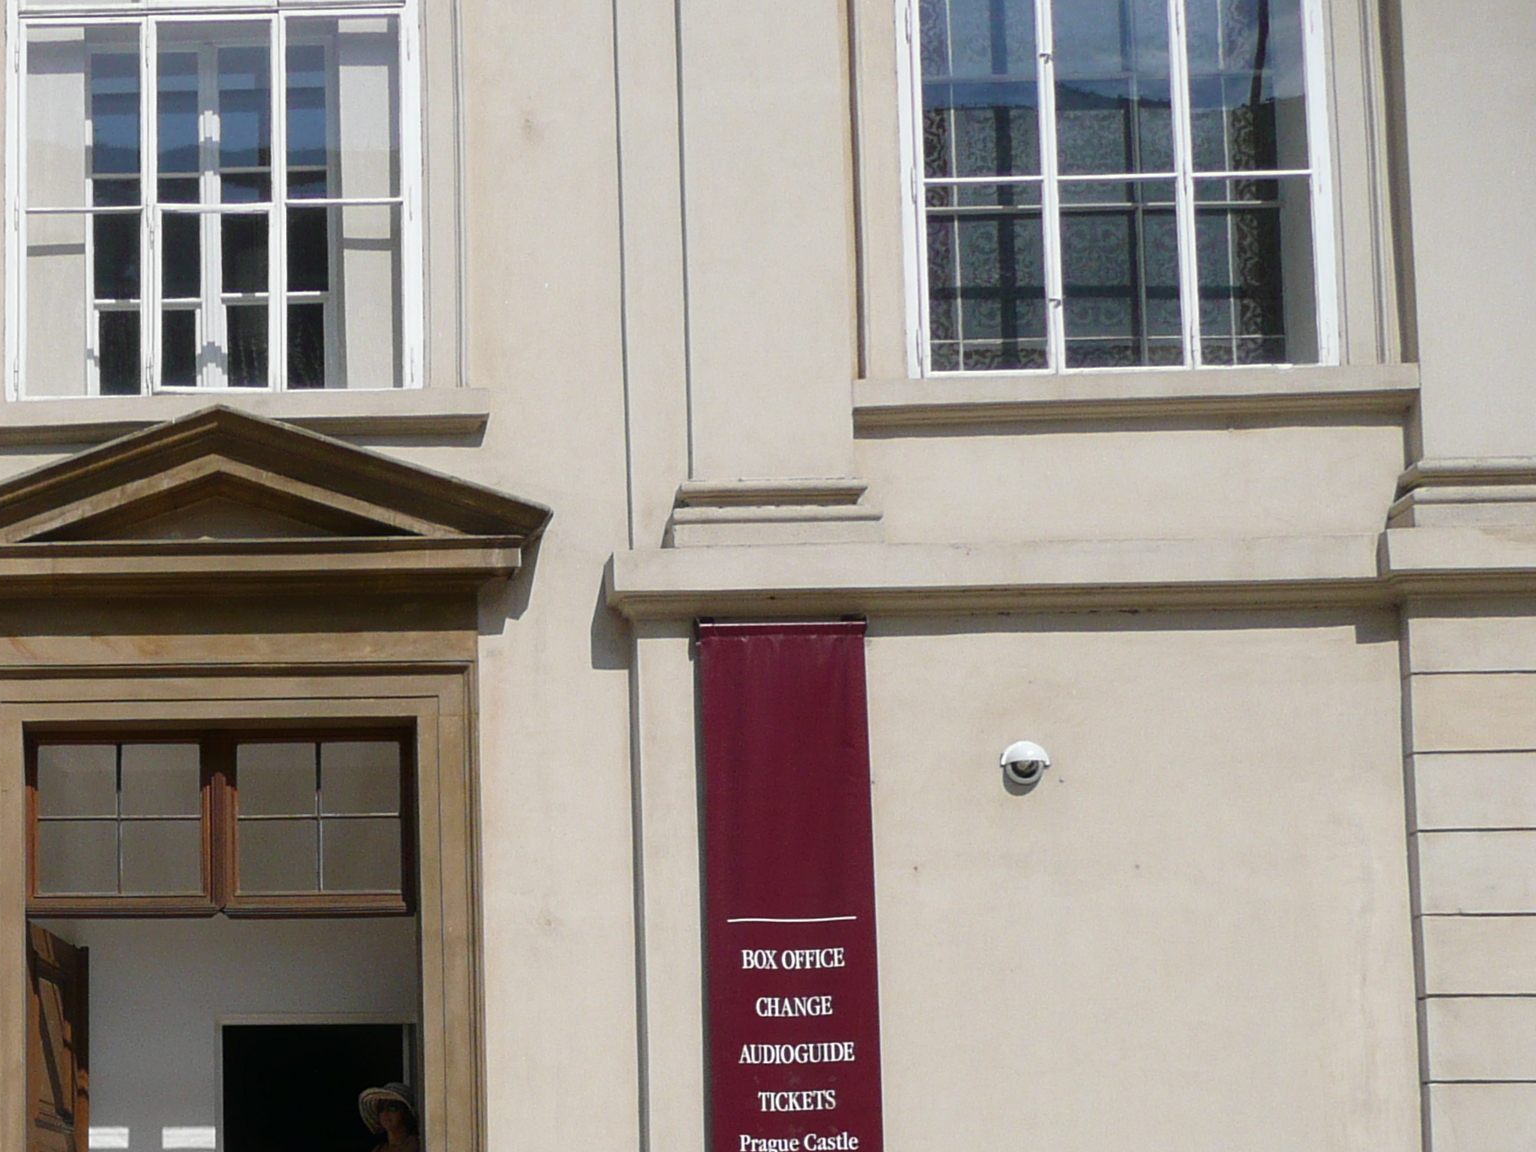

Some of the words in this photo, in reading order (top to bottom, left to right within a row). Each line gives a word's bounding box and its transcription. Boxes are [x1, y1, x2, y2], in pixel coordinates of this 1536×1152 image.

[741, 949, 778, 970] BOX
[781, 947, 845, 970] OFFICE
[755, 995, 833, 1017] CHANGE
[738, 1042, 855, 1065] AUDIOGUIDE
[757, 1089, 836, 1112] TICKETS
[803, 1132, 859, 1151] Castle
